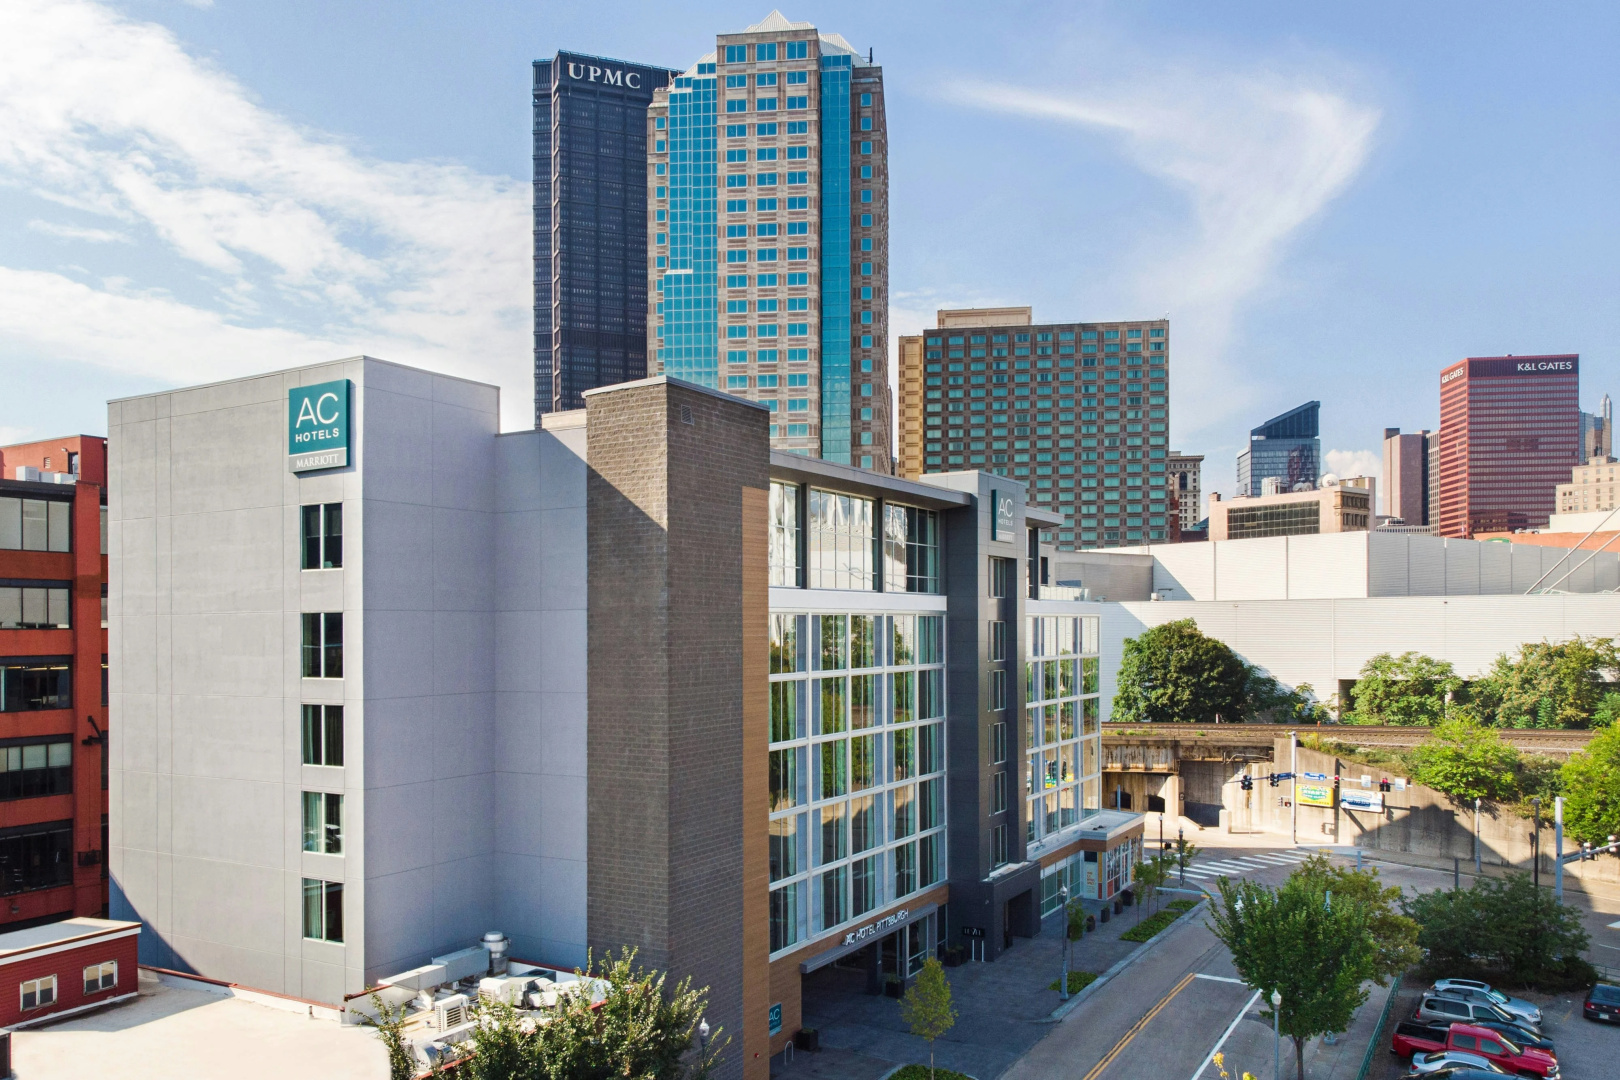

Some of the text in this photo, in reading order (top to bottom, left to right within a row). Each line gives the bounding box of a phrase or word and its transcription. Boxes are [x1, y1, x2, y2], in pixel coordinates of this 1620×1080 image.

[567, 62, 640, 89] UPMC
[1450, 367, 1464, 380] GATES
[1518, 362, 1572, 371] K&L GATES
[296, 392, 339, 428] AC
[295, 428, 340, 443] HOTELS
[296, 454, 339, 469] MARRIOTT
[998, 498, 1013, 517] AC
[998, 519, 1014, 527] HOTELS
[845, 908, 909, 946] AC HOTEL PITTSBURGH
[769, 1008, 780, 1021] AC
